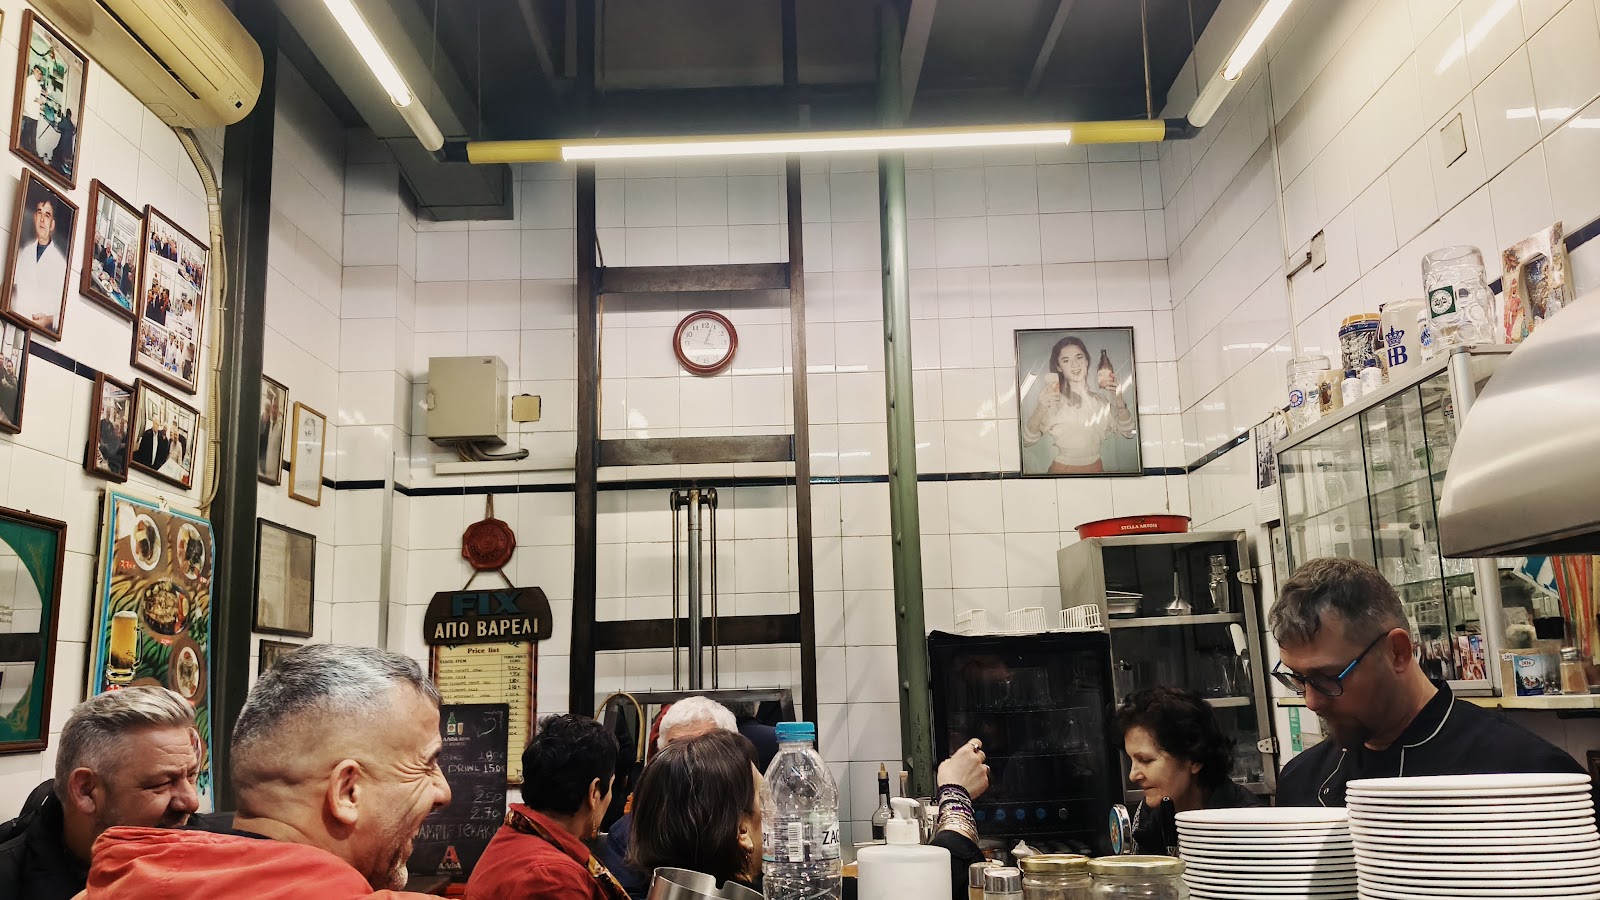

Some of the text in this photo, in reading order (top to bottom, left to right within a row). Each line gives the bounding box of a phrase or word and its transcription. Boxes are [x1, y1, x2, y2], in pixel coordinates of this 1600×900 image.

[1387, 345, 1408, 368] HB
[452, 591, 524, 617] FIX
[434, 618, 539, 639] ΑΠΟ ΒΑΡΕΛΙ
